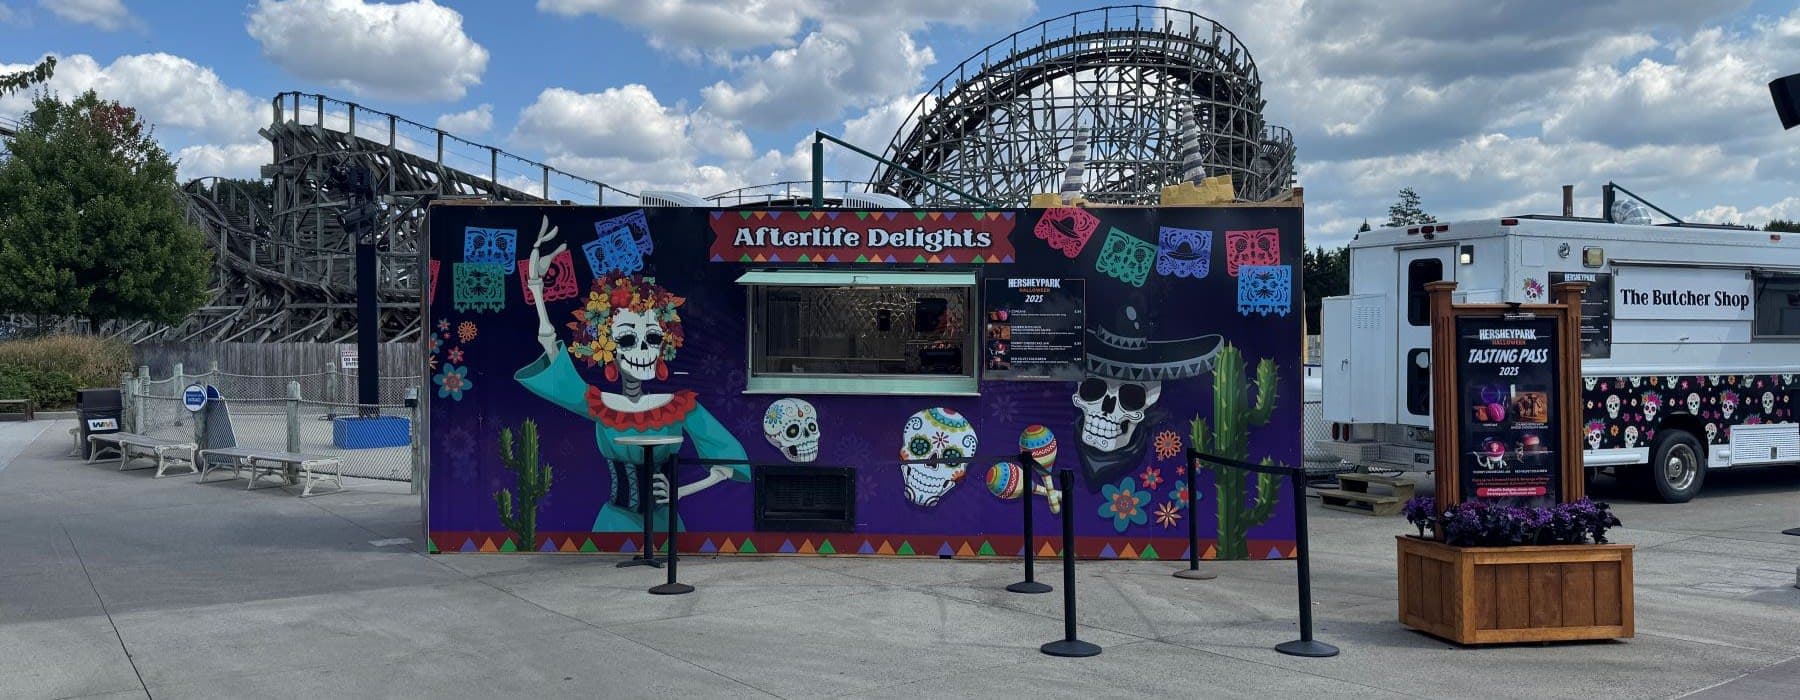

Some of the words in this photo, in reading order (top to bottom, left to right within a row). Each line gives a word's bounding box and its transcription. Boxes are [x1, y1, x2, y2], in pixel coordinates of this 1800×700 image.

[733, 227, 860, 247] Afterlife
[867, 227, 992, 252] Delights
[1008, 278, 1061, 288] HERSHEYPARK
[1024, 294, 1044, 303] 2025
[1620, 288, 1649, 306] The
[1652, 289, 1711, 307] Butcher
[1714, 290, 1750, 311] Shop
[1479, 328, 1537, 340] HERSHEYPARK
[1467, 348, 1519, 363] TASTING
[1519, 348, 1549, 363] PASS
[1498, 366, 1520, 376] 2025
